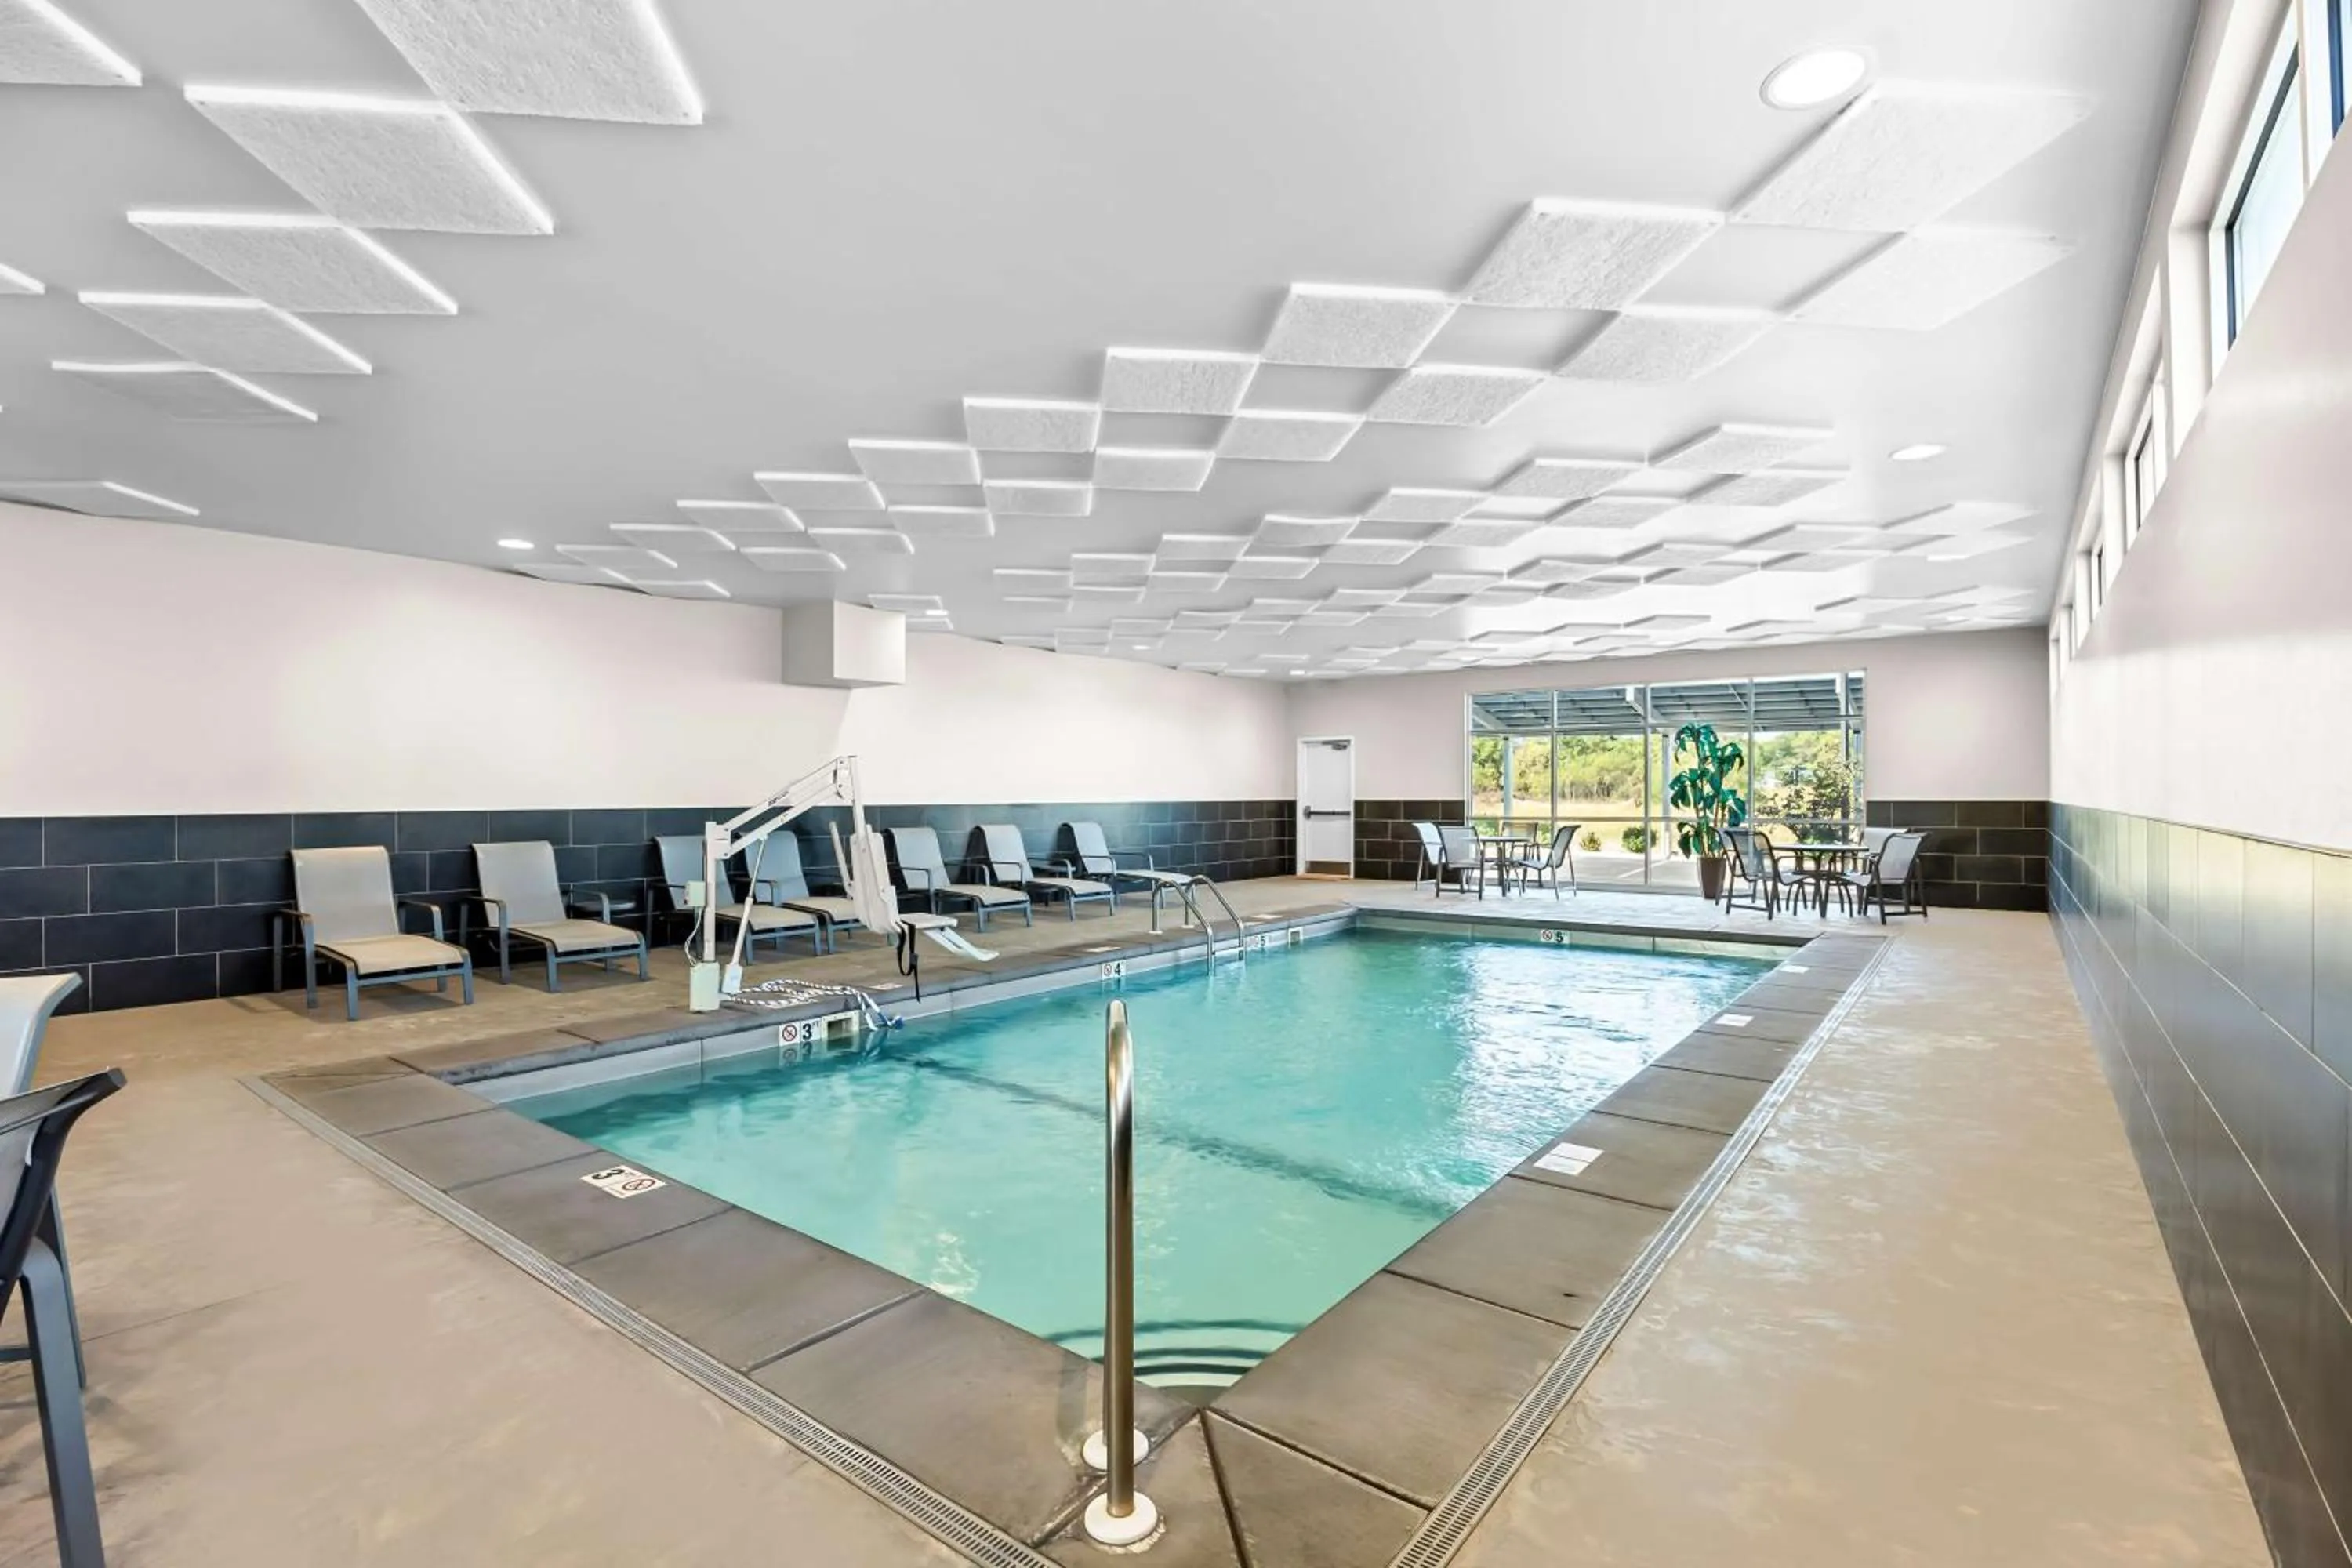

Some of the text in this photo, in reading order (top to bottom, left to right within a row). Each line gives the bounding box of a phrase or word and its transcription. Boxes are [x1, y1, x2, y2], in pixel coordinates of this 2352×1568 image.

[1260, 935, 1266, 946] 5
[1556, 931, 1564, 943] 5
[1114, 962, 1121, 976] 4
[802, 1023, 812, 1040] 3
[591, 1168, 625, 1180] 3
